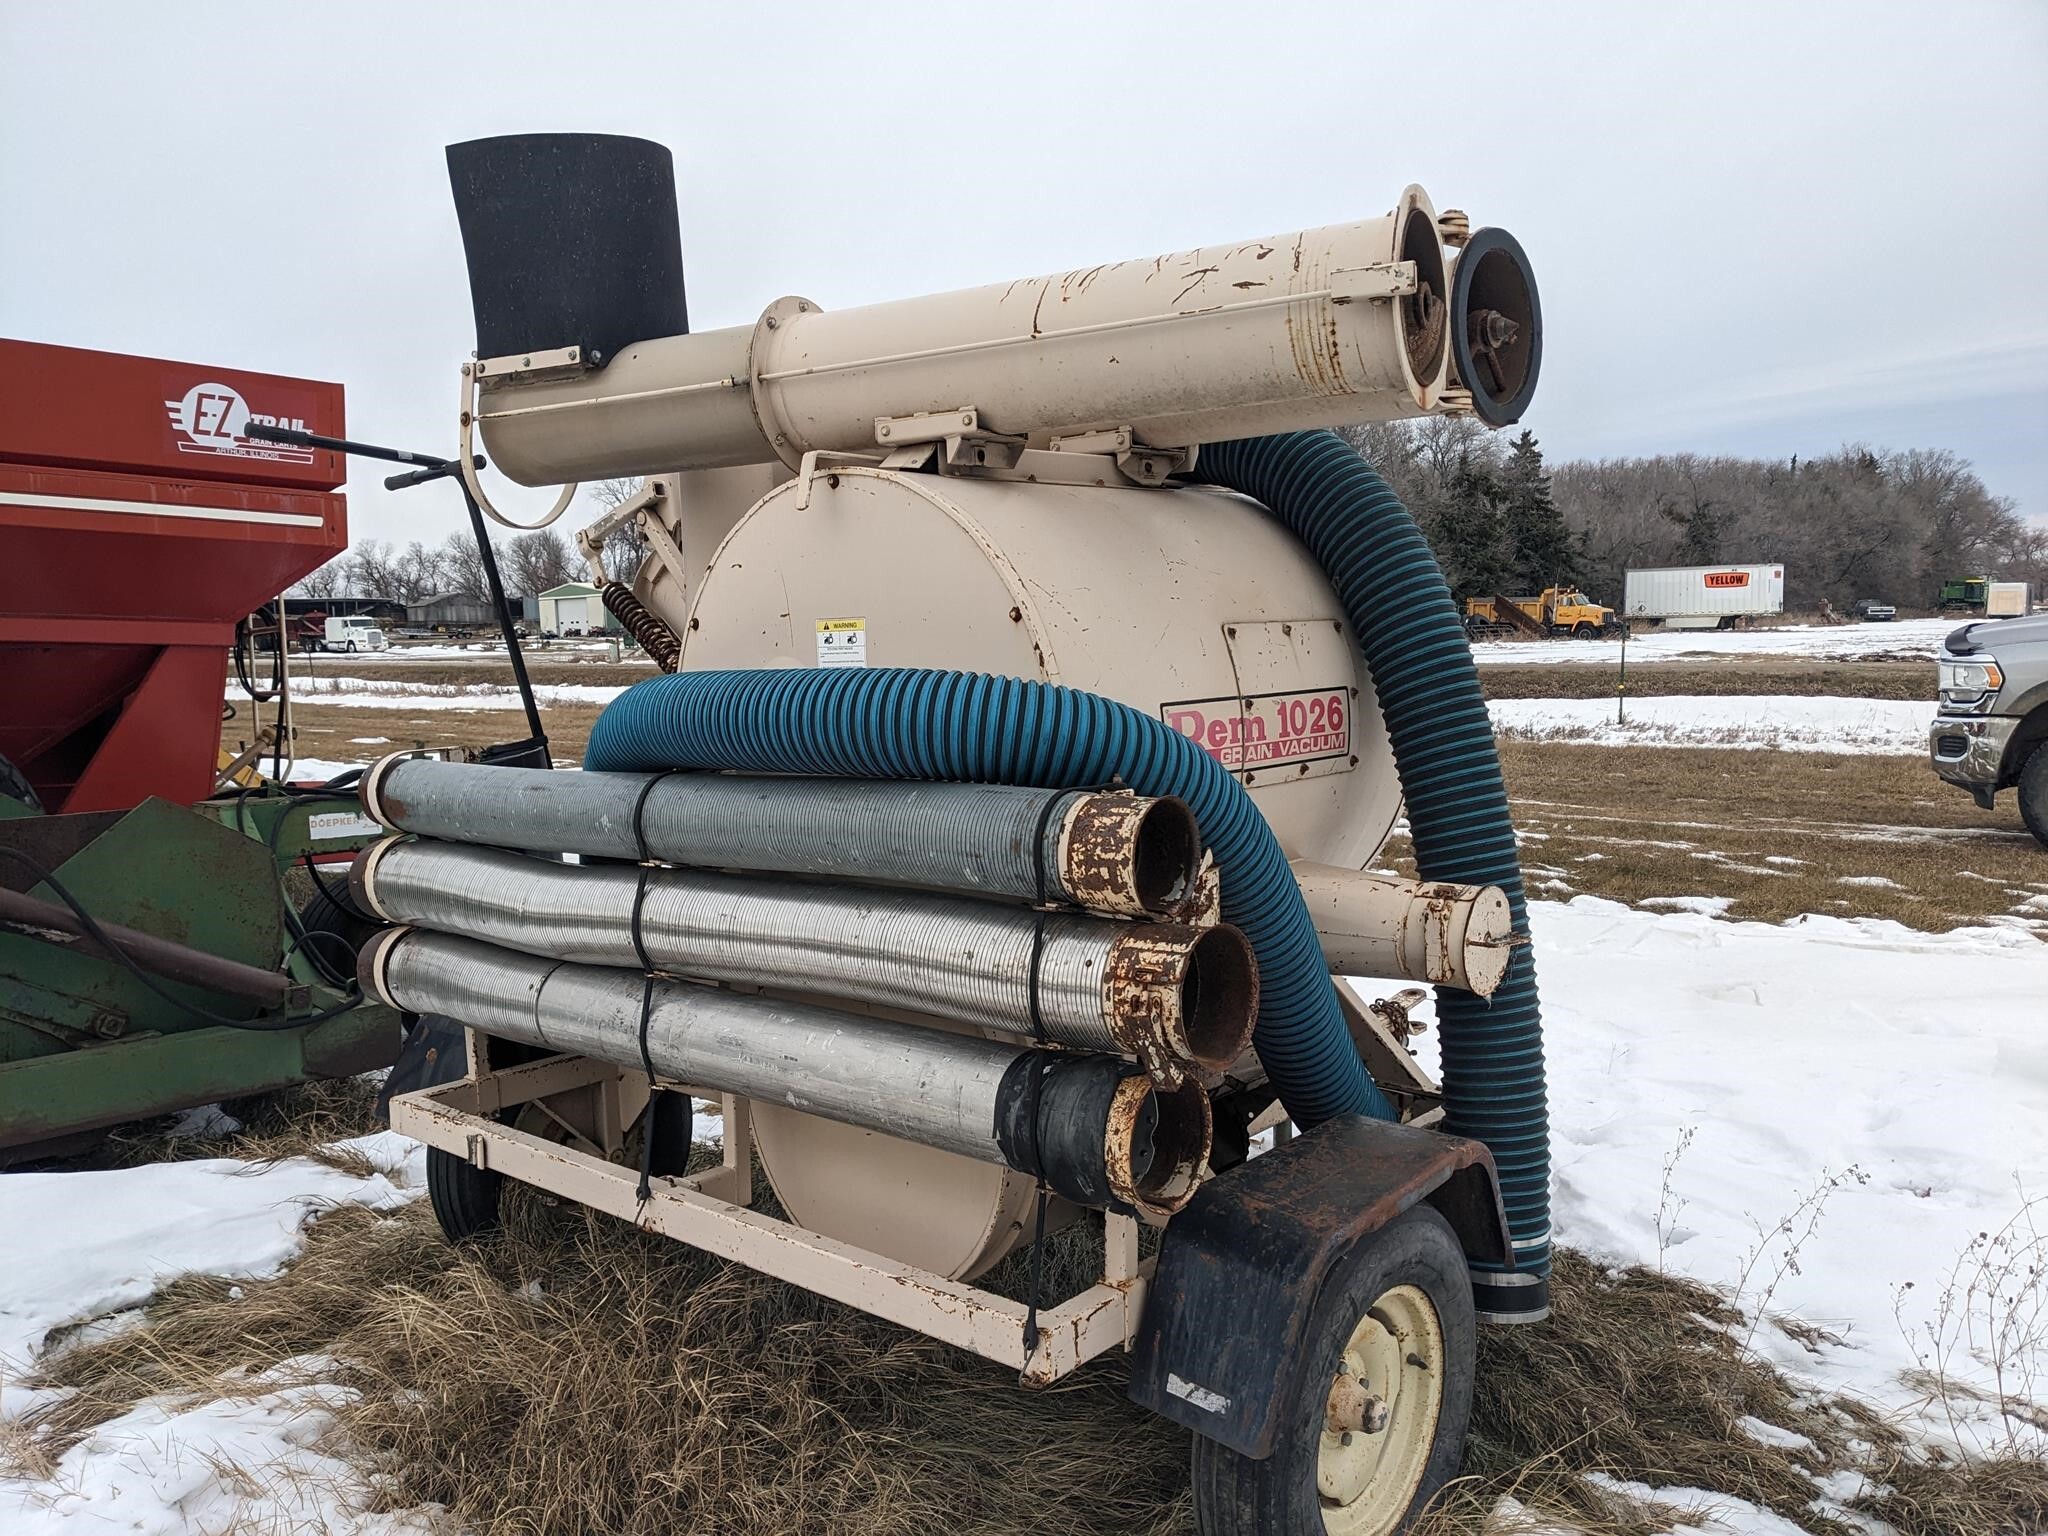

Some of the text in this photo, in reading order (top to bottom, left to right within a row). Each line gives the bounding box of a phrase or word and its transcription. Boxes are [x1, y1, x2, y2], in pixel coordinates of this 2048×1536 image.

[192, 393, 236, 438] E-Z
[249, 450, 279, 460] ILLINOIS
[1710, 575, 1744, 585] YELLOW
[1277, 695, 1344, 739] 1026
[1220, 734, 1344, 763] GRAIN VACUUM
